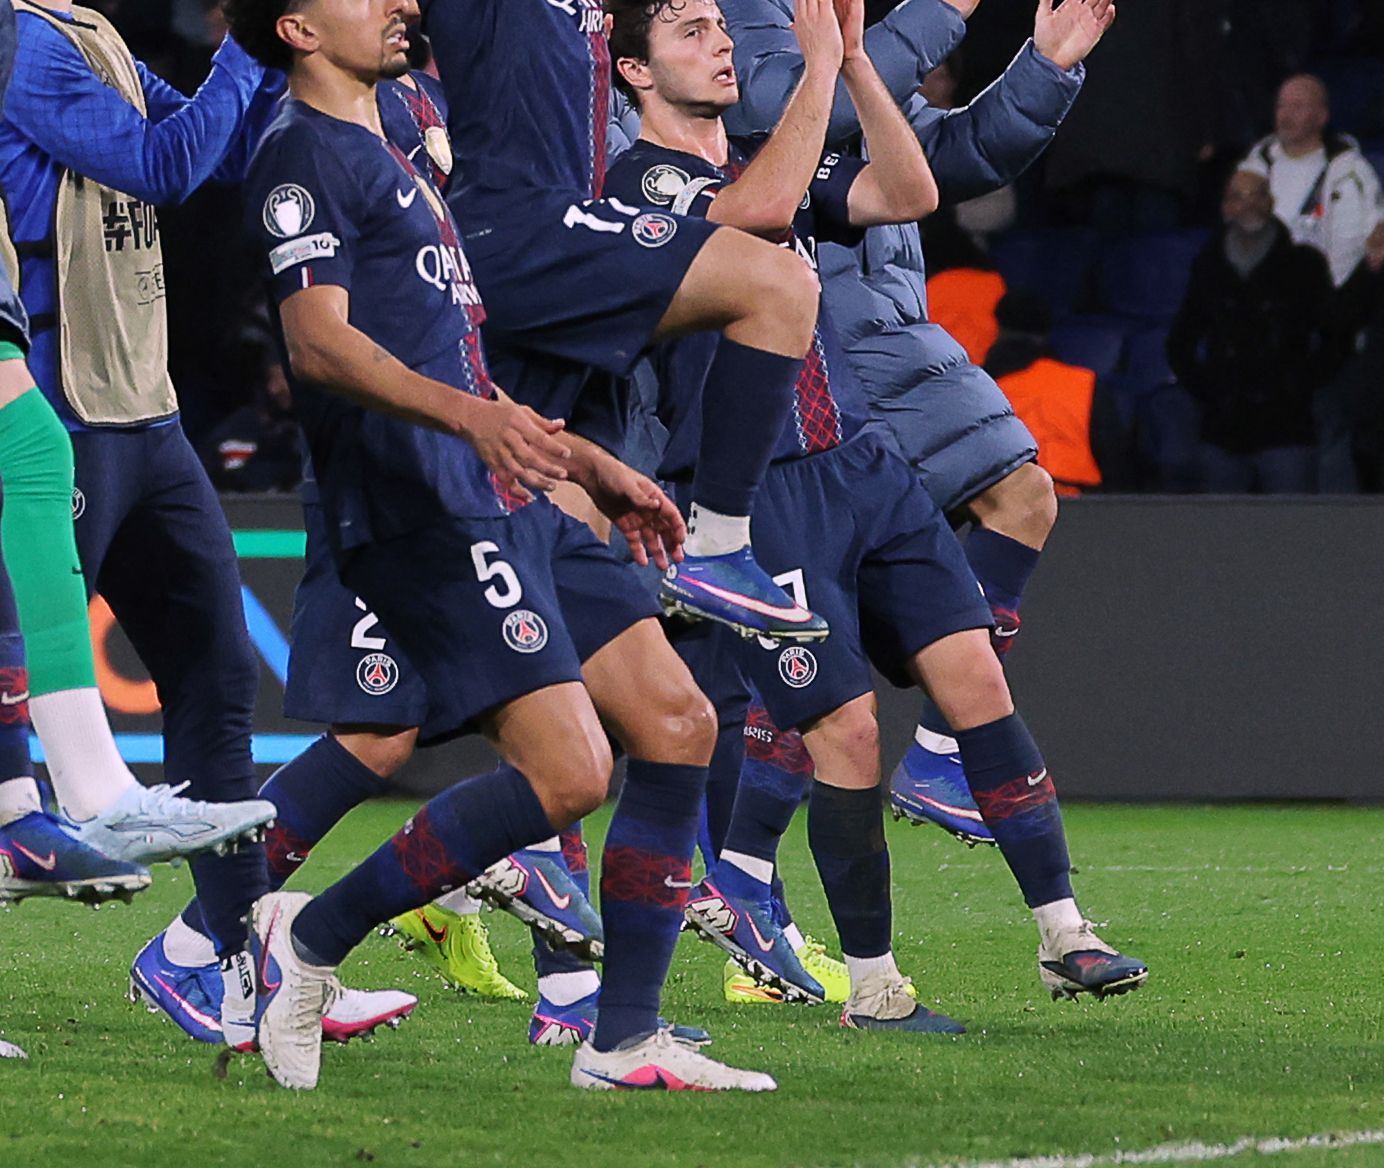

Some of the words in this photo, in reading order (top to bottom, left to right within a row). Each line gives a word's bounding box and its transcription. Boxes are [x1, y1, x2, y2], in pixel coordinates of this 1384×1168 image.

[470, 540, 523, 608] 5
[758, 568, 809, 651] 7
[364, 654, 393, 668] PARIS
[781, 648, 806, 663] PARIS
